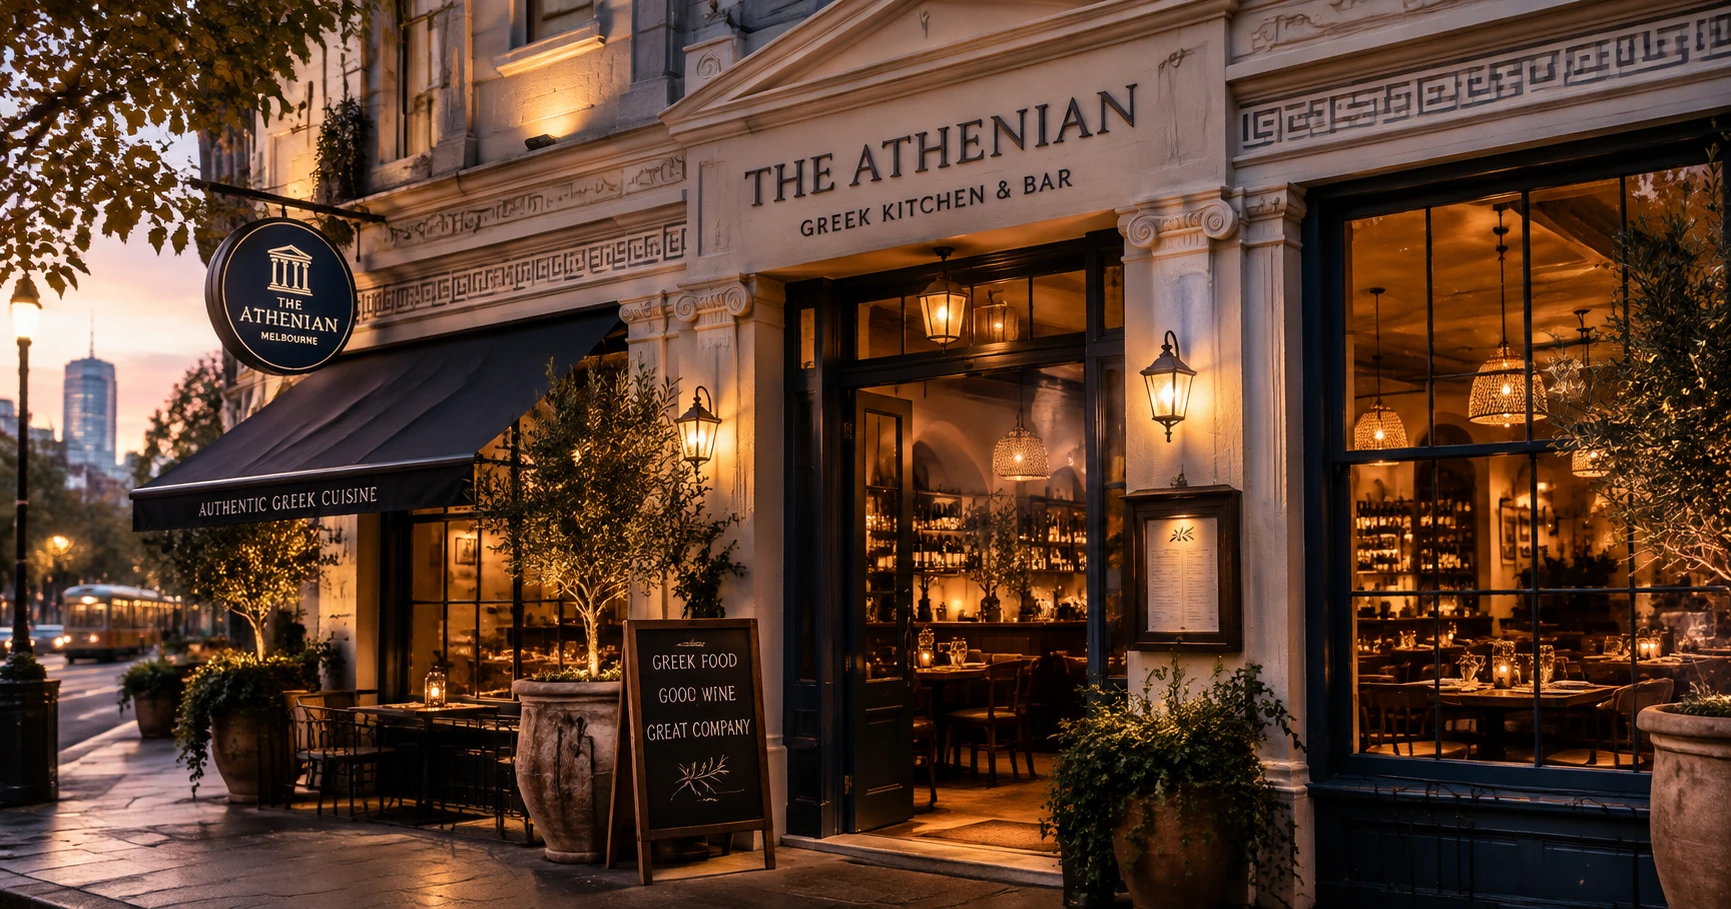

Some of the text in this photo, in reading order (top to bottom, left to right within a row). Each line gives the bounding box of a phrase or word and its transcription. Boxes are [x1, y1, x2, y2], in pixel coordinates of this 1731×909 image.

[745, 83, 1137, 207] THE ATHENIAN
[801, 168, 1073, 237] GREEK KITCHEN & BAR
[276, 296, 303, 311] THE
[239, 306, 339, 333] ATHENIAN
[260, 331, 318, 346] MELBOURNE
[198, 486, 378, 517] AUTHENTIC GREEK CUISINE
[652, 652, 738, 671] GREEK FOOD
[701, 685, 737, 702] WINE
[646, 718, 751, 741] GREAT COMPANY
